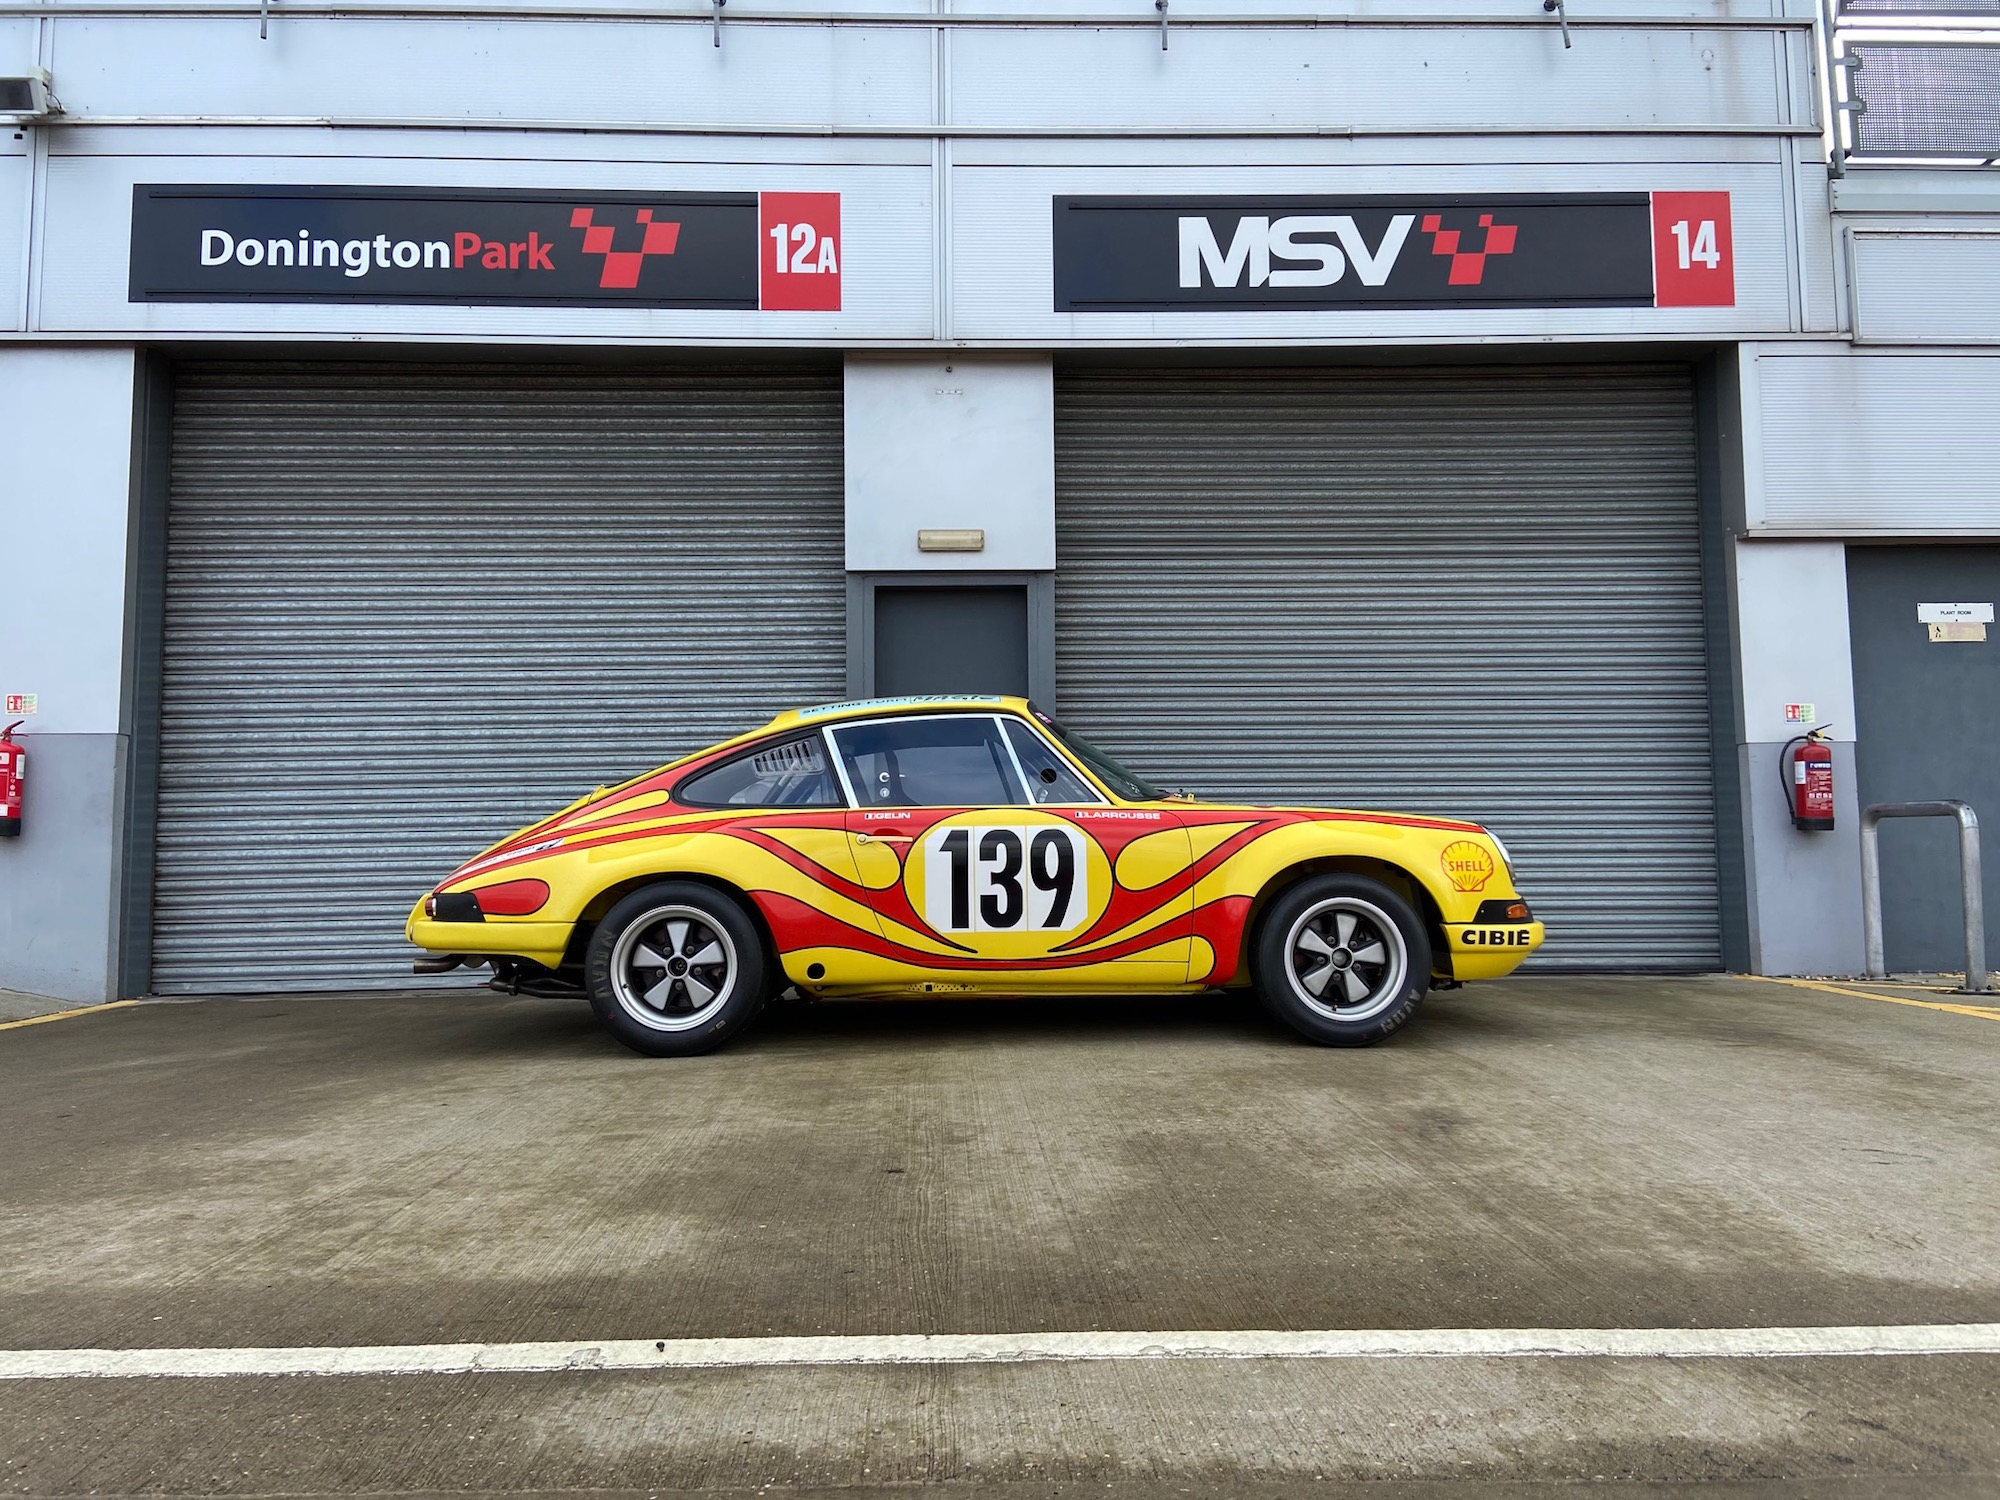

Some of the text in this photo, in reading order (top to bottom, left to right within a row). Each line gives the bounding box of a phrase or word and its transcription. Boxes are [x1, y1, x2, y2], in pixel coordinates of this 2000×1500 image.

[770, 223, 838, 274] 12A
[1178, 215, 1416, 288] MSV
[1671, 220, 1720, 269] 14
[1086, 811, 1160, 820] LARROUSSE
[939, 829, 1075, 928] 139
[1448, 860, 1485, 871] SHELL
